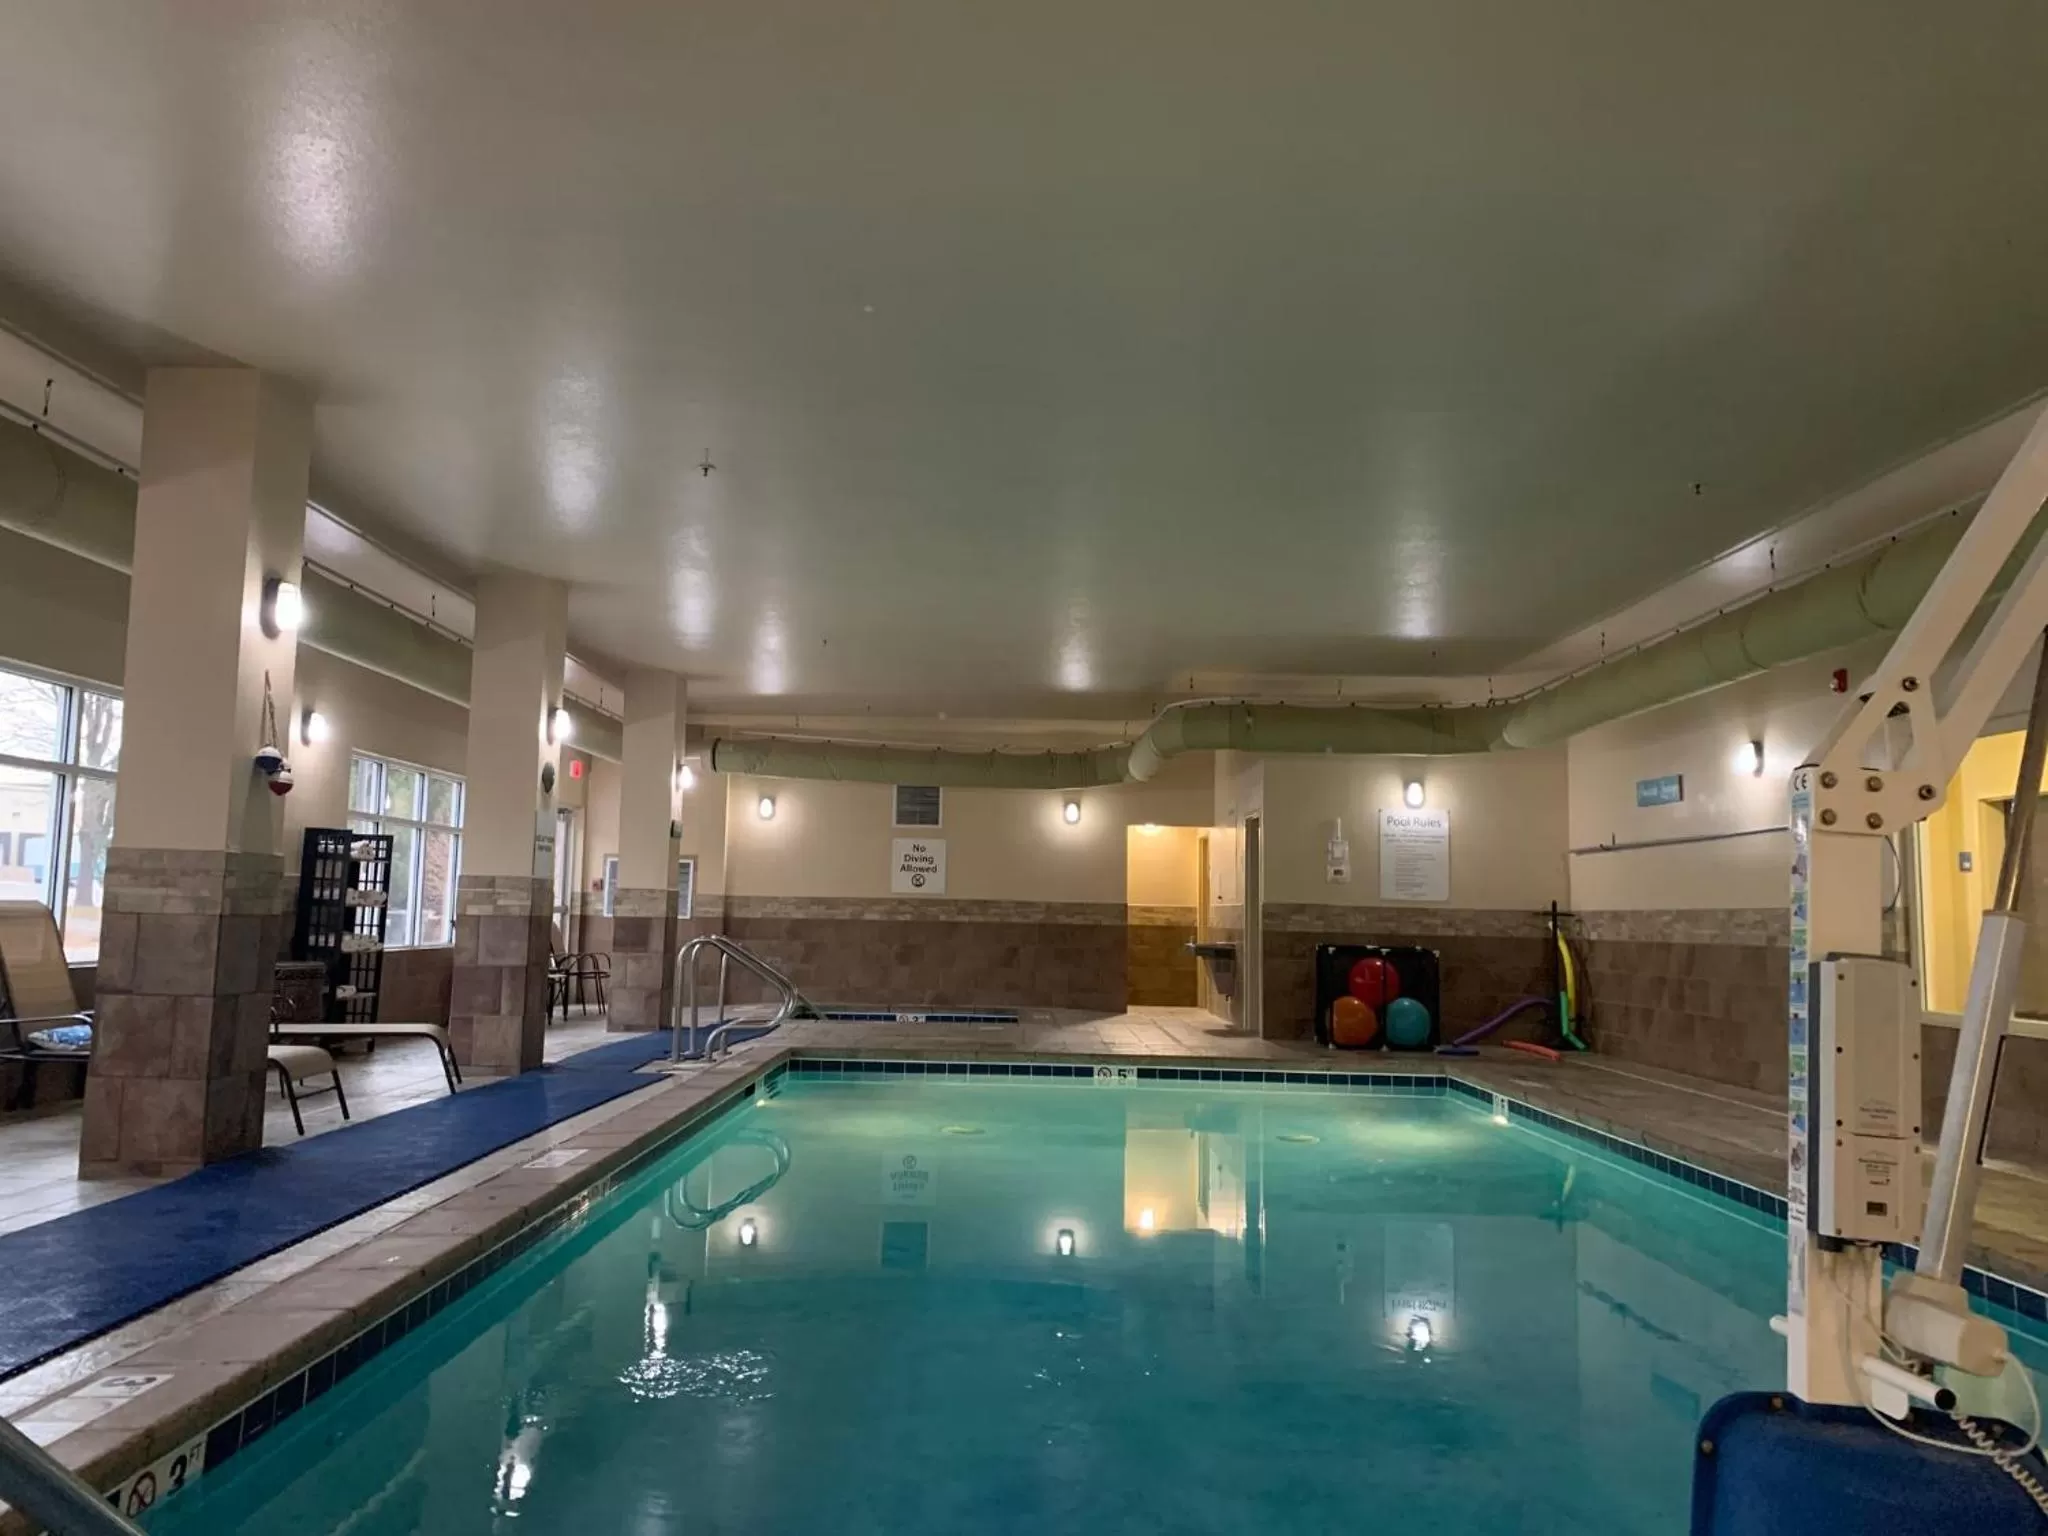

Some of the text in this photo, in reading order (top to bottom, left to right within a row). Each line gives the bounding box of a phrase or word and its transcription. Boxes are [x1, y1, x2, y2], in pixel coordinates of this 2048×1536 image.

[1387, 815, 1441, 829] Pool Rules
[912, 844, 926, 853] No
[903, 854, 935, 865] Diving
[899, 864, 938, 874] Allowed
